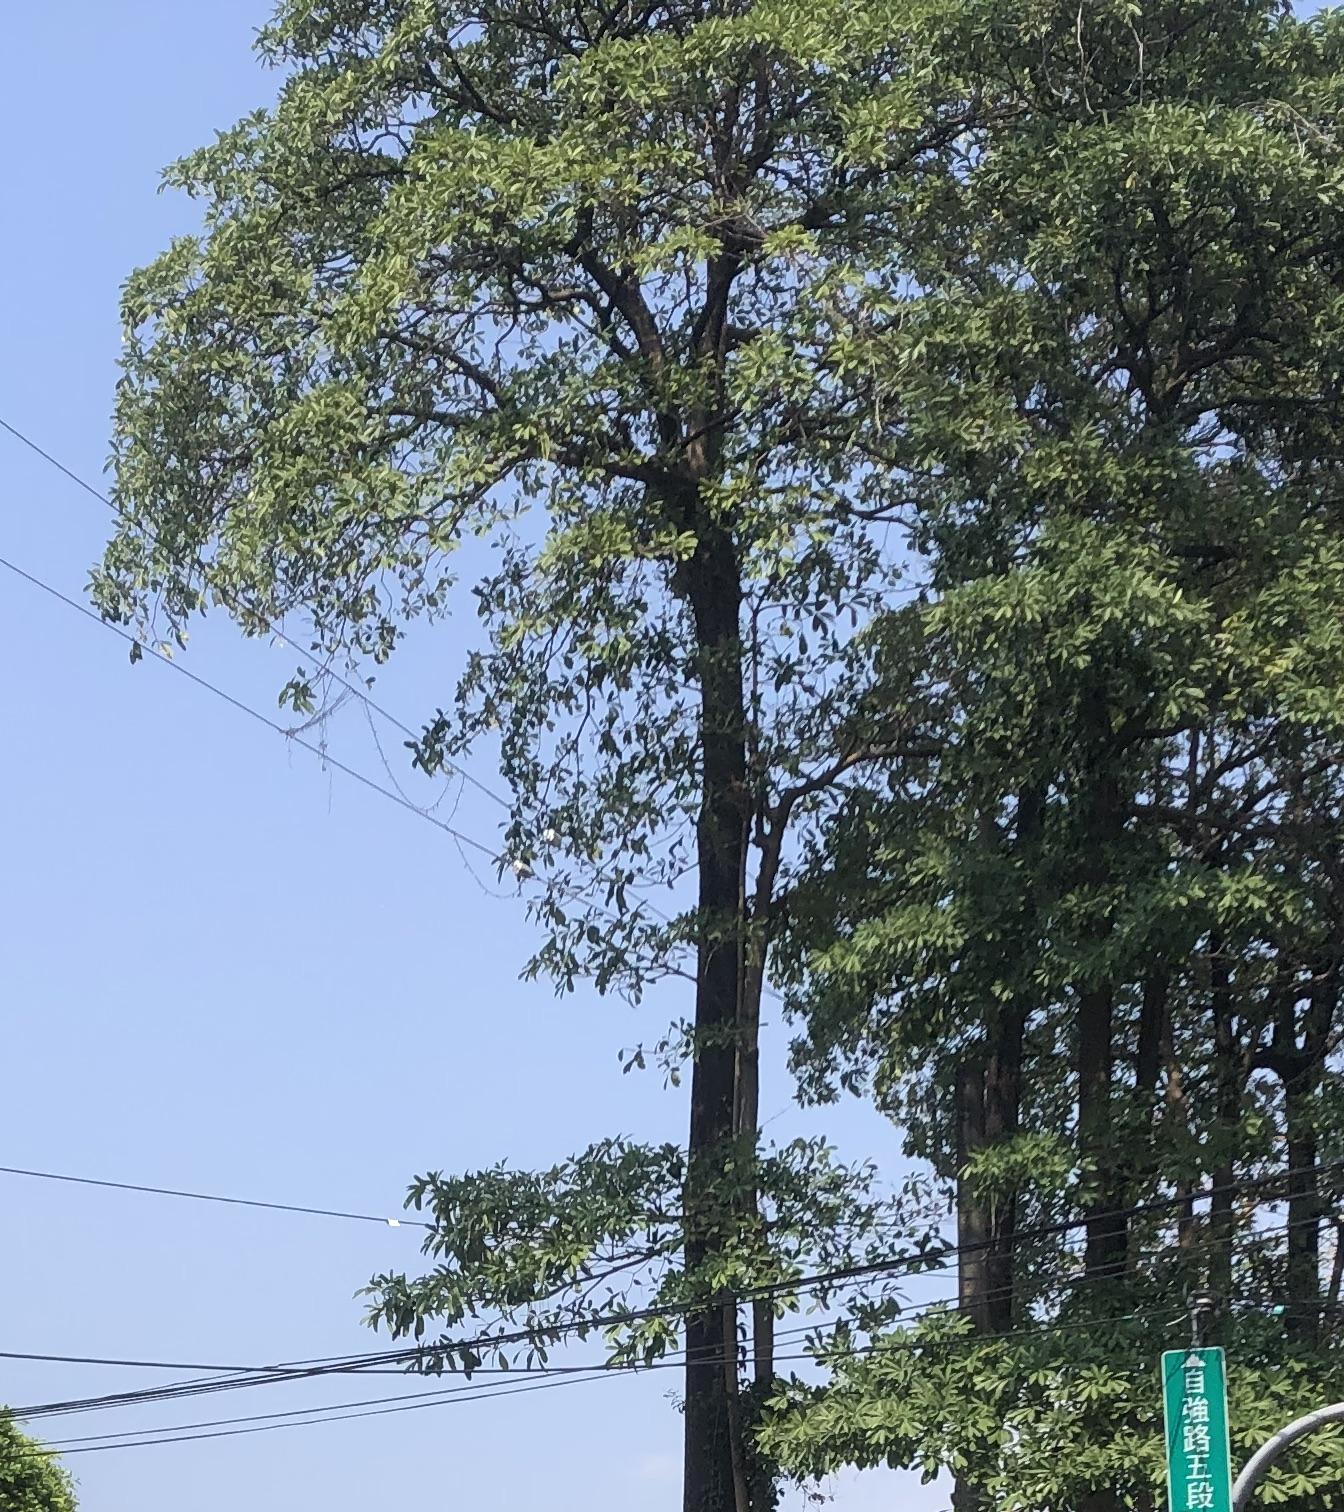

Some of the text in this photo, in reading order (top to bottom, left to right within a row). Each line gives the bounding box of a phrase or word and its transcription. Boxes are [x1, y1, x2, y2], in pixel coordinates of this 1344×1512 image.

[1182, 1369, 1214, 1510] 自強路五段
